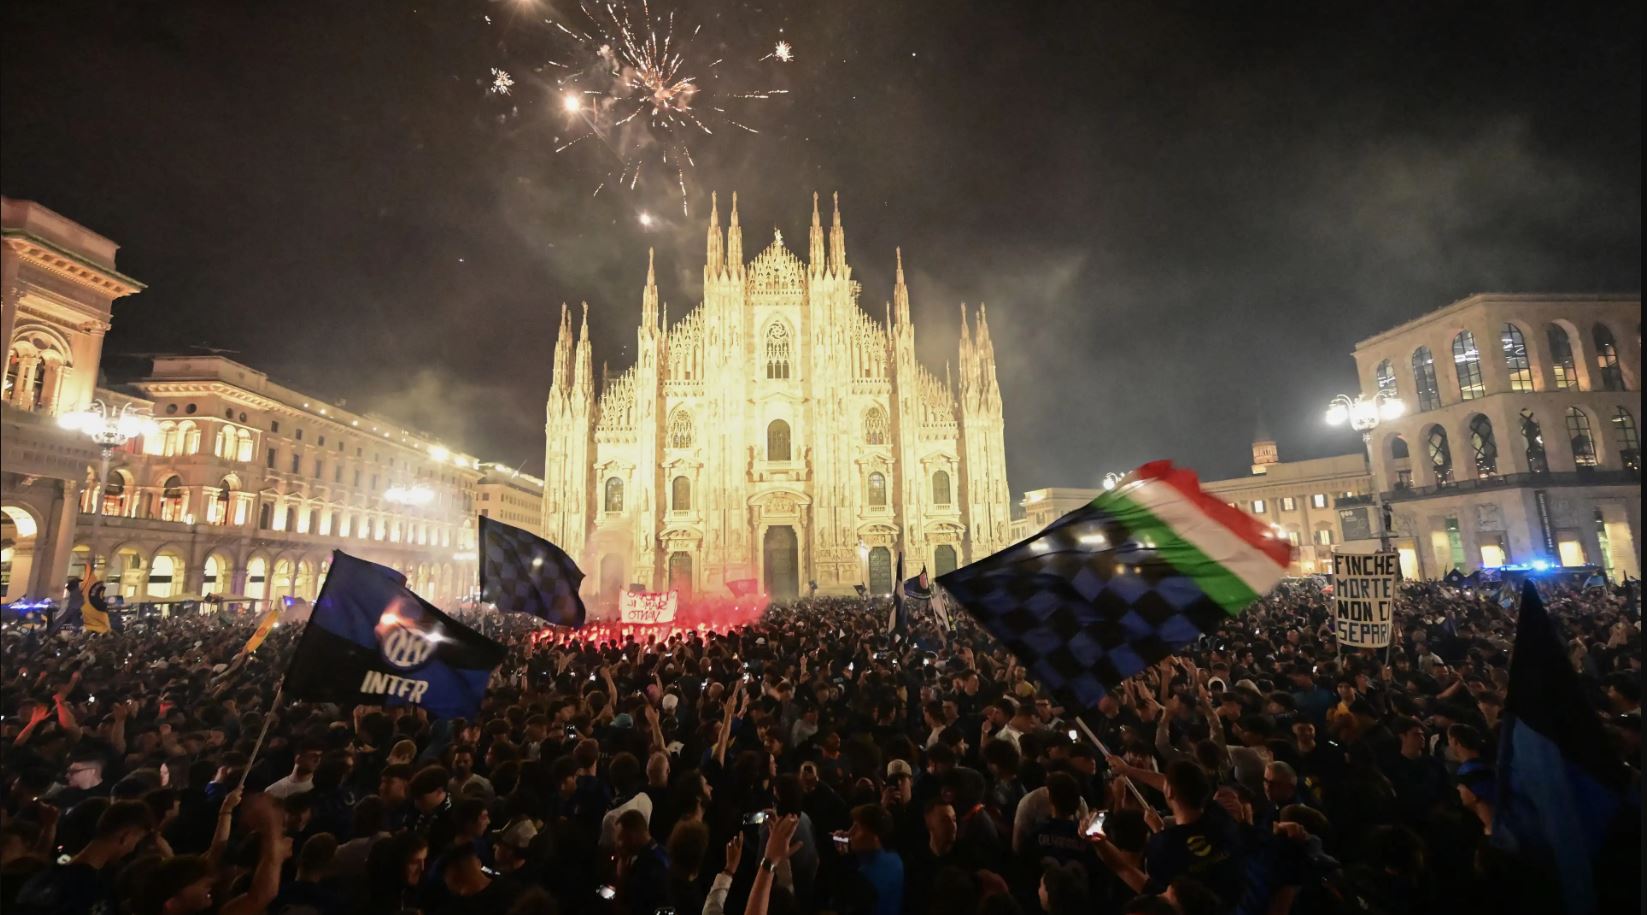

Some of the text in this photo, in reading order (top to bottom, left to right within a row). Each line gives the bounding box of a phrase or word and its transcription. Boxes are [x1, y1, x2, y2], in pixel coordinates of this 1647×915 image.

[1337, 578, 1392, 598] MORTE
[1337, 600, 1391, 621] NON CI
